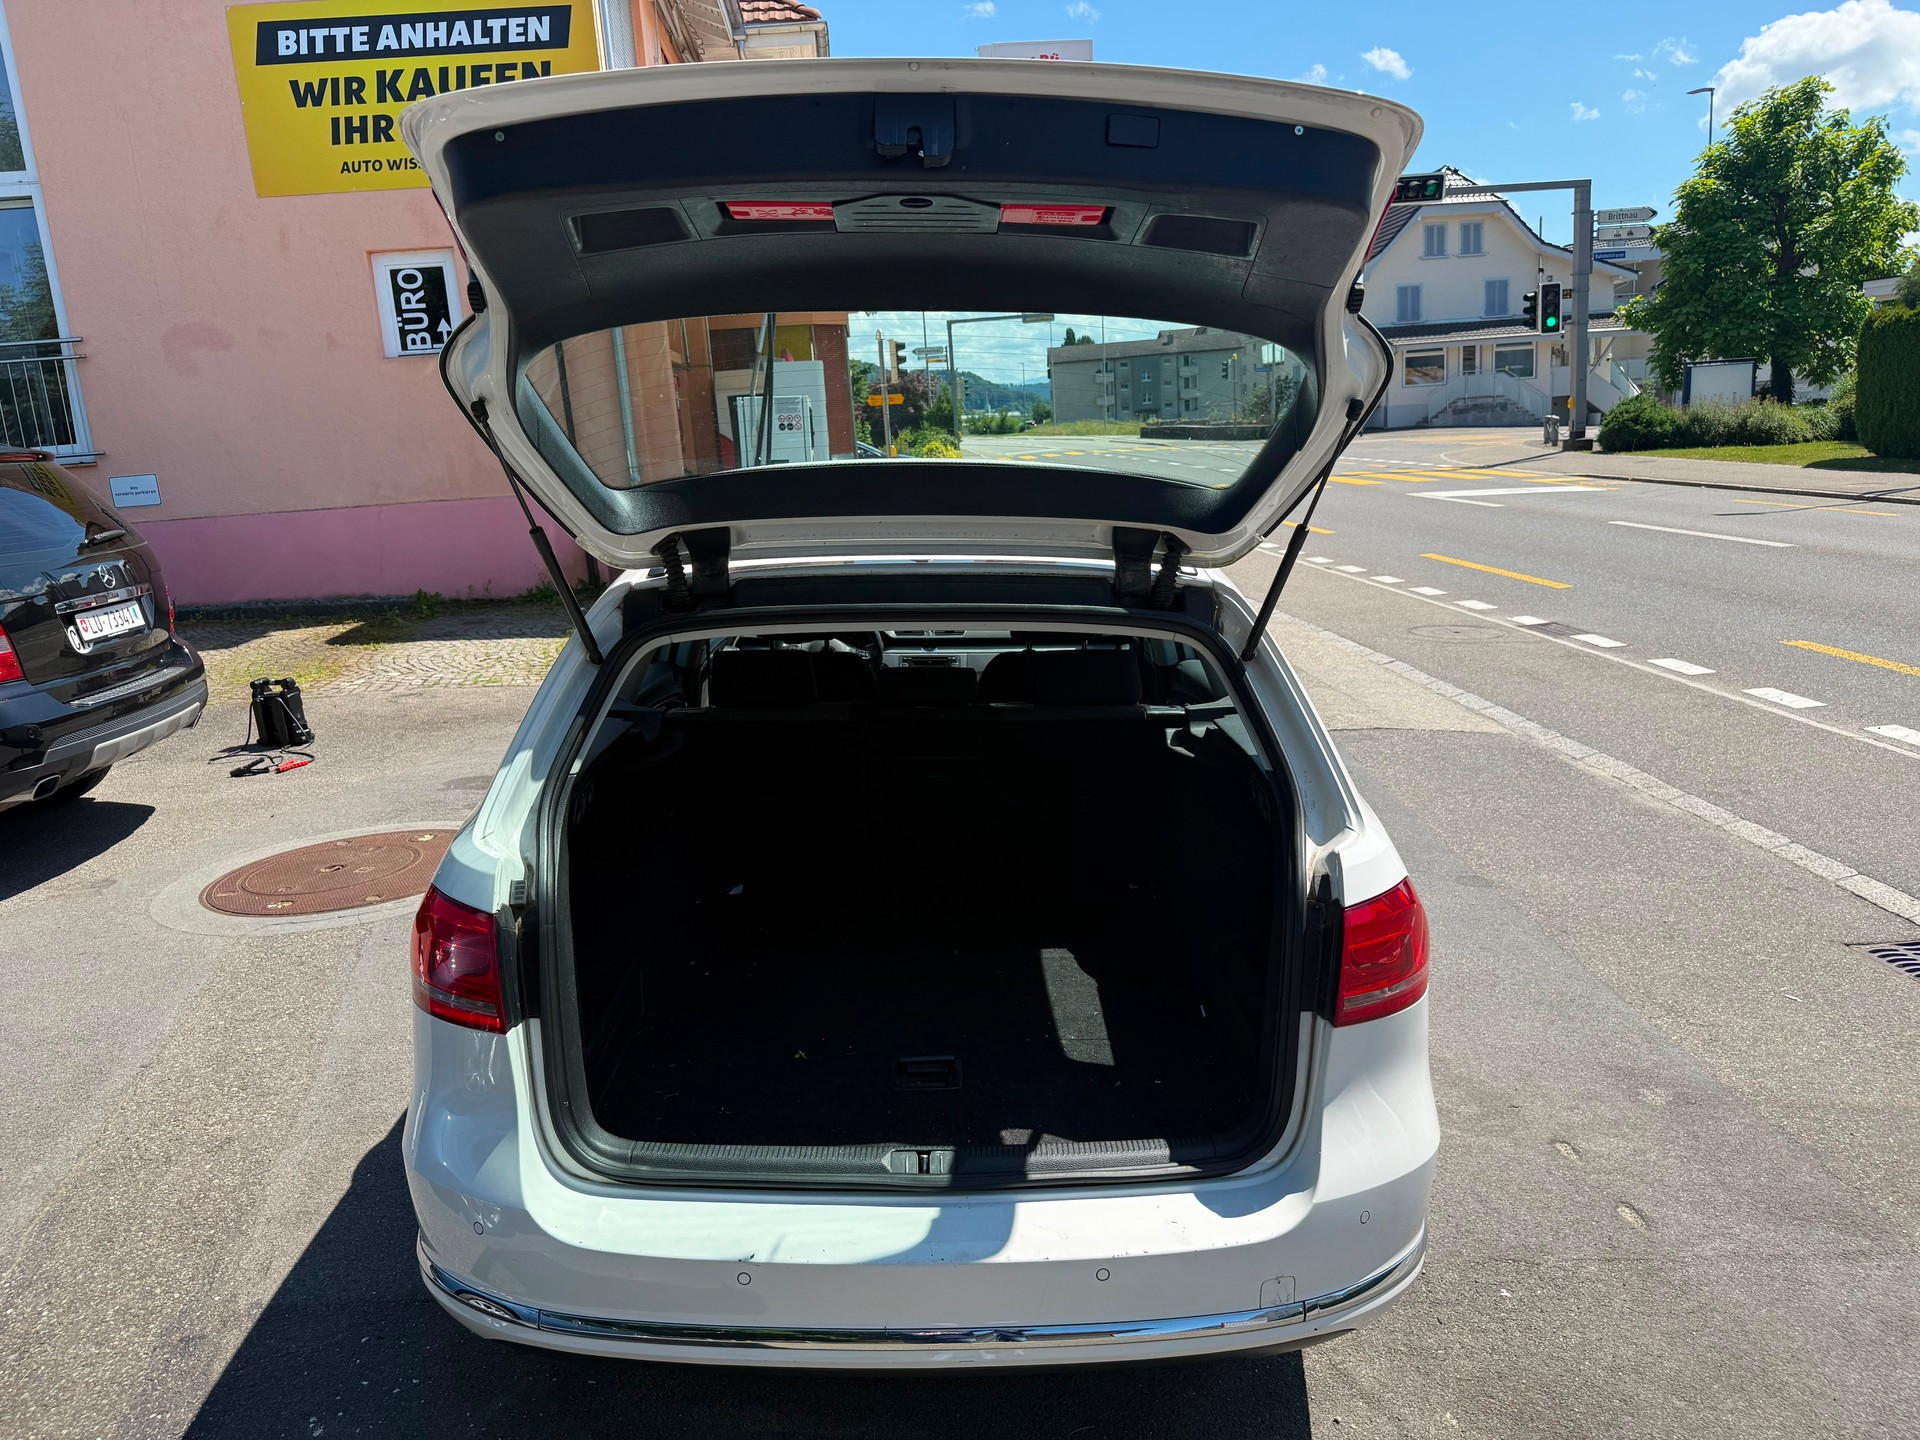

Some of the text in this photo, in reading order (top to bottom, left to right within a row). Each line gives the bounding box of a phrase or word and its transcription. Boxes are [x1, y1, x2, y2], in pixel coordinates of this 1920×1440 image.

[277, 15, 550, 56] BITTE ANHALTEN
[289, 75, 367, 108] WIR
[331, 114, 395, 146] IHR
[340, 157, 422, 174] AUTO WIS
[1608, 211, 1638, 221] Brittnau
[397, 268, 433, 351] BÜRO
